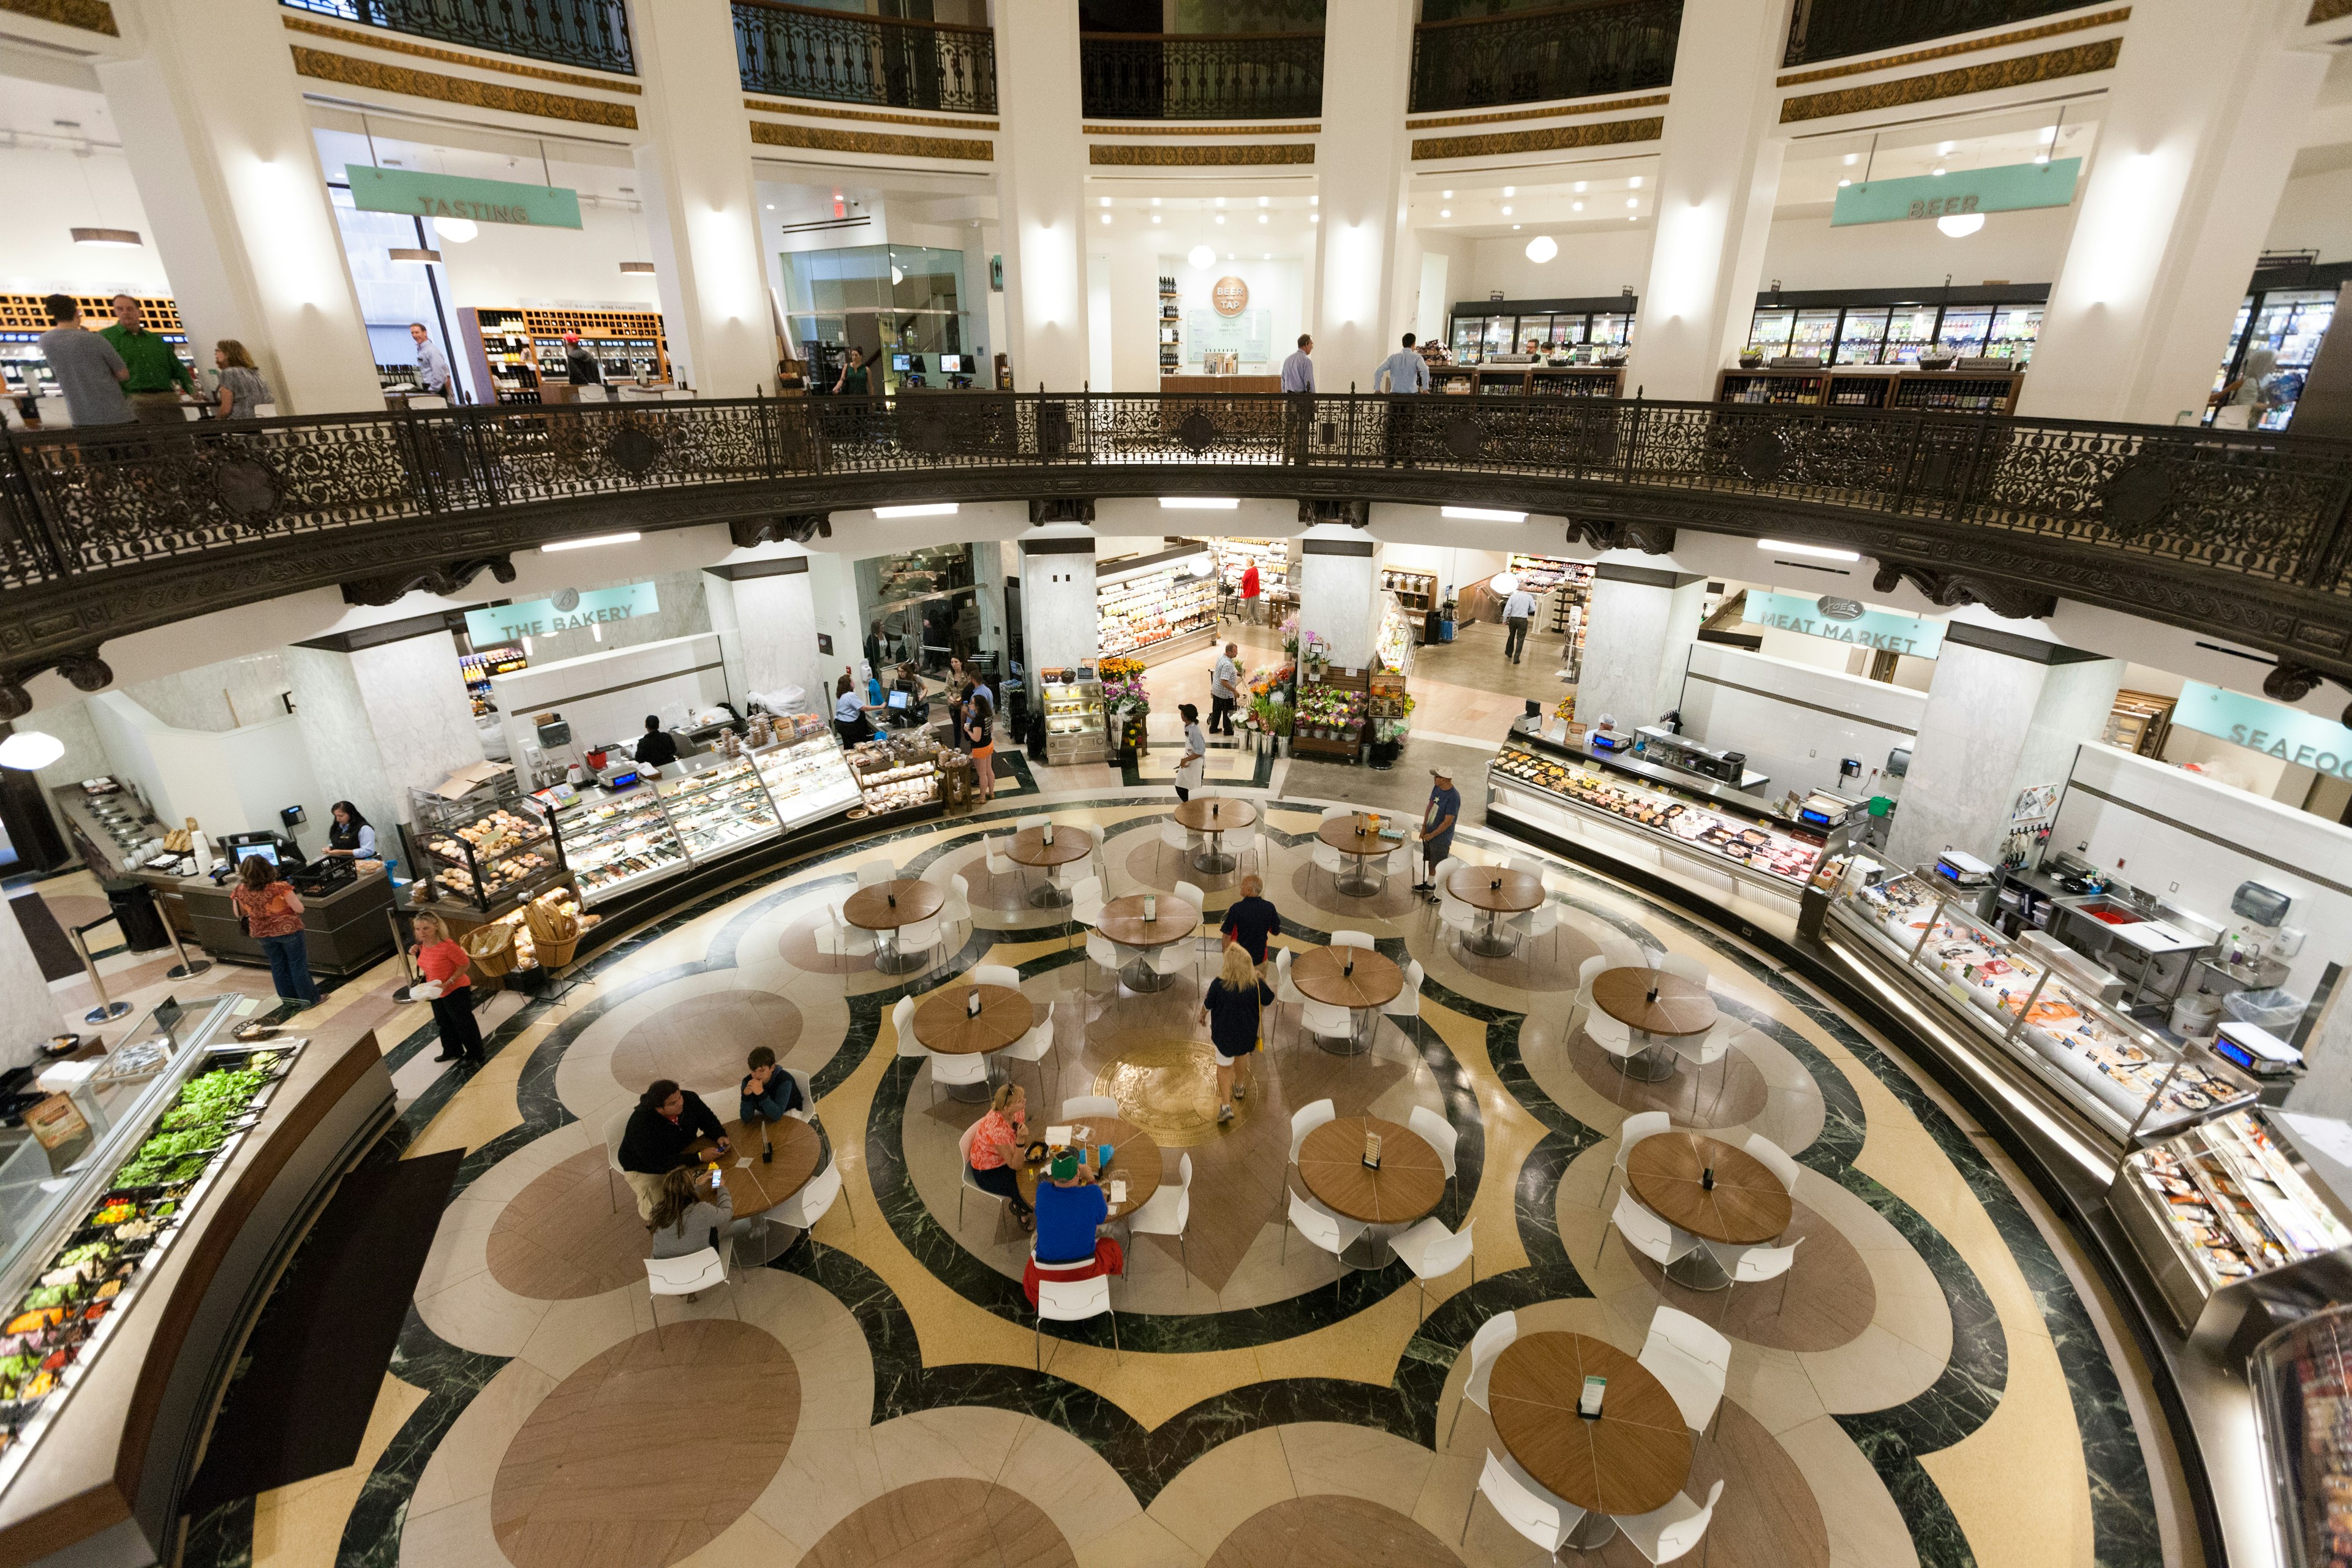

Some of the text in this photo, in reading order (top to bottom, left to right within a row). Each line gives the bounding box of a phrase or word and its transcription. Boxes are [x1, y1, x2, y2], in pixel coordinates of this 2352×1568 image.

[418, 196, 529, 225] TASTING
[1908, 195, 1978, 221] BEER
[1217, 287, 1243, 296] BEER
[1221, 301, 1240, 311] TAP
[501, 604, 633, 640] THE BAKERY
[1760, 611, 1918, 654] MEAT MARKET
